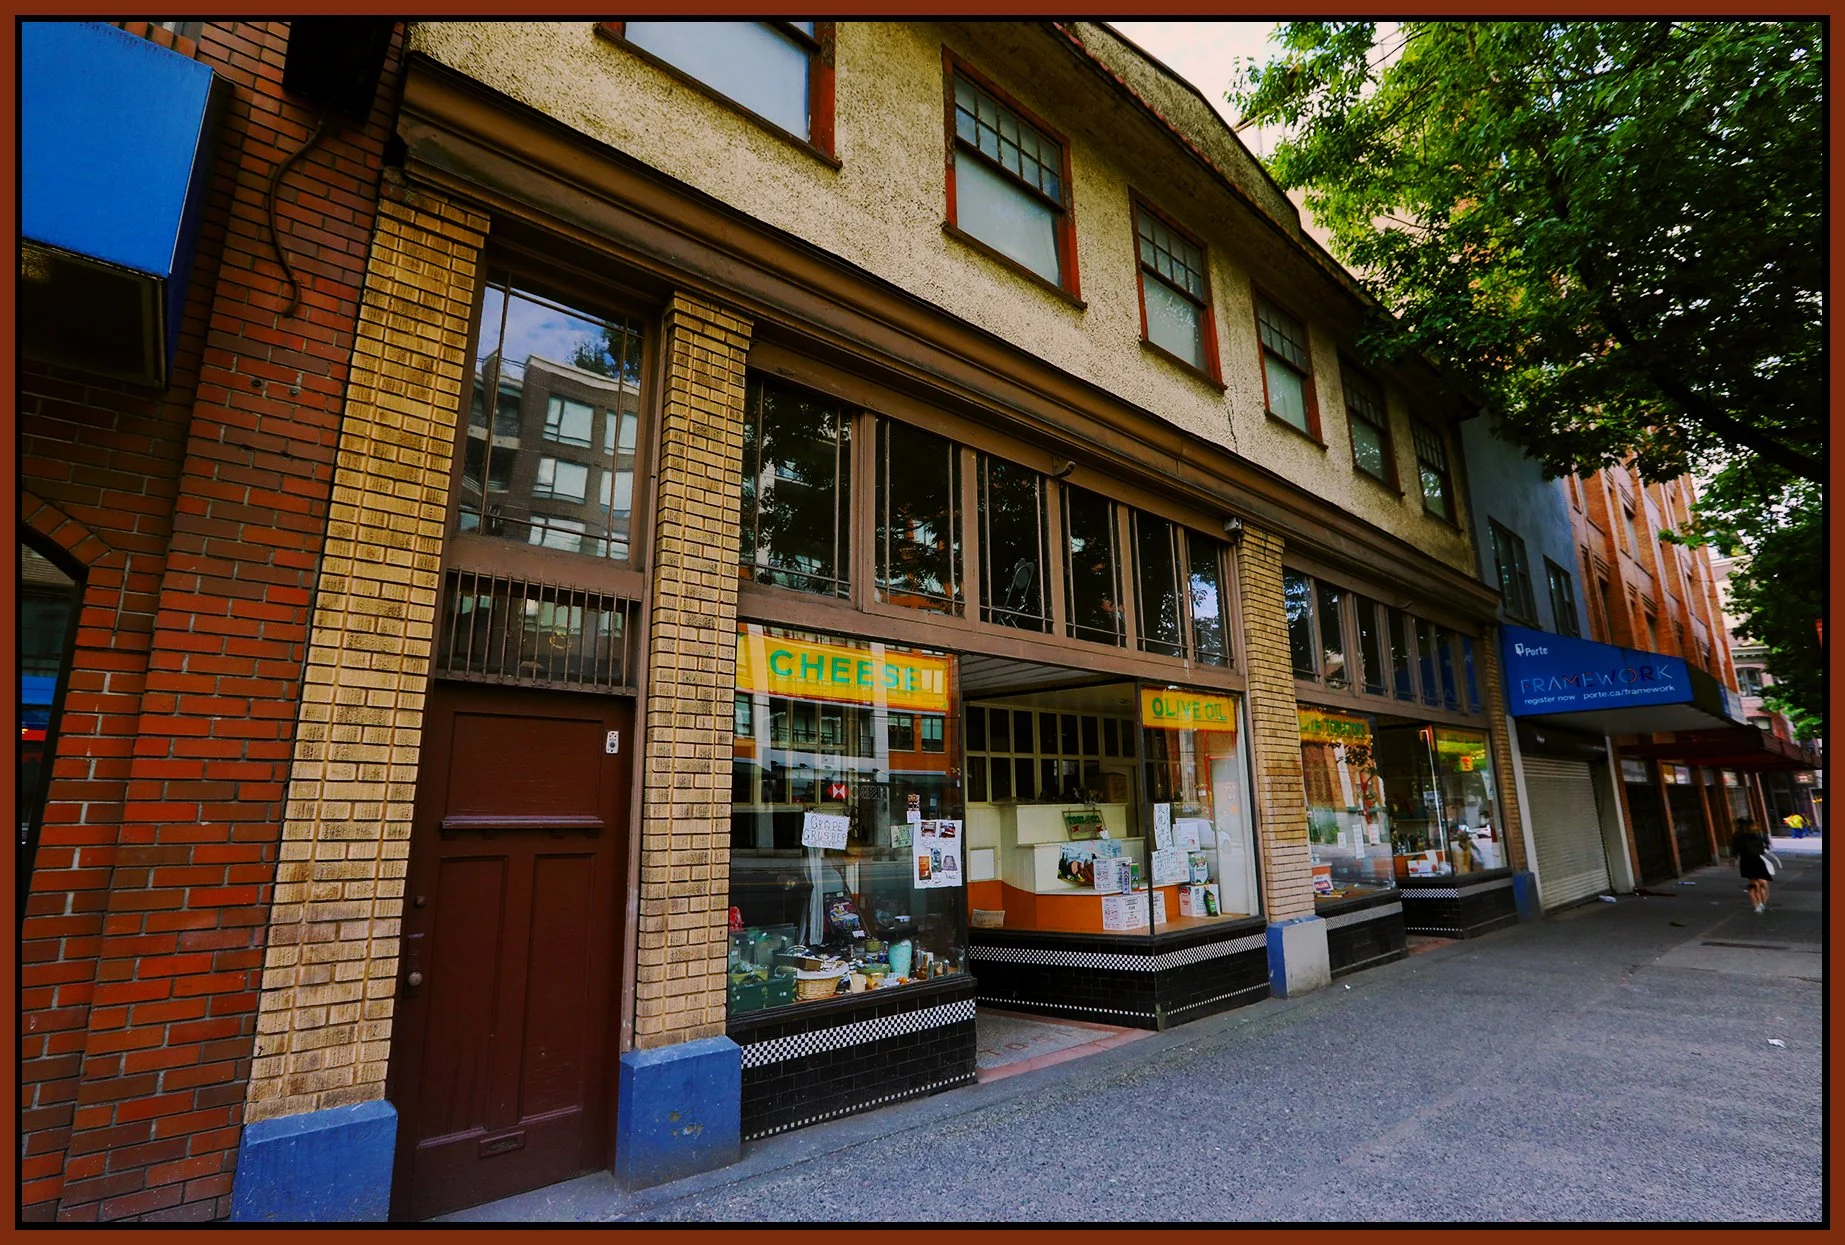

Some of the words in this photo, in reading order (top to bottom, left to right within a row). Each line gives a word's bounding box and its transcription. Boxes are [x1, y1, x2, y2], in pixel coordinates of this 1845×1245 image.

[1525, 646, 1548, 657] Porte
[770, 649, 921, 691] CHEESE
[1520, 663, 1673, 694] FRAMEWORK
[1524, 696, 1555, 705] register
[1557, 694, 1576, 702] now
[1583, 684, 1676, 701] porte.ca/framework
[1152, 697, 1201, 719] OLIVE
[1204, 703, 1227, 721] OIL
[810, 815, 843, 832] GRAPE
